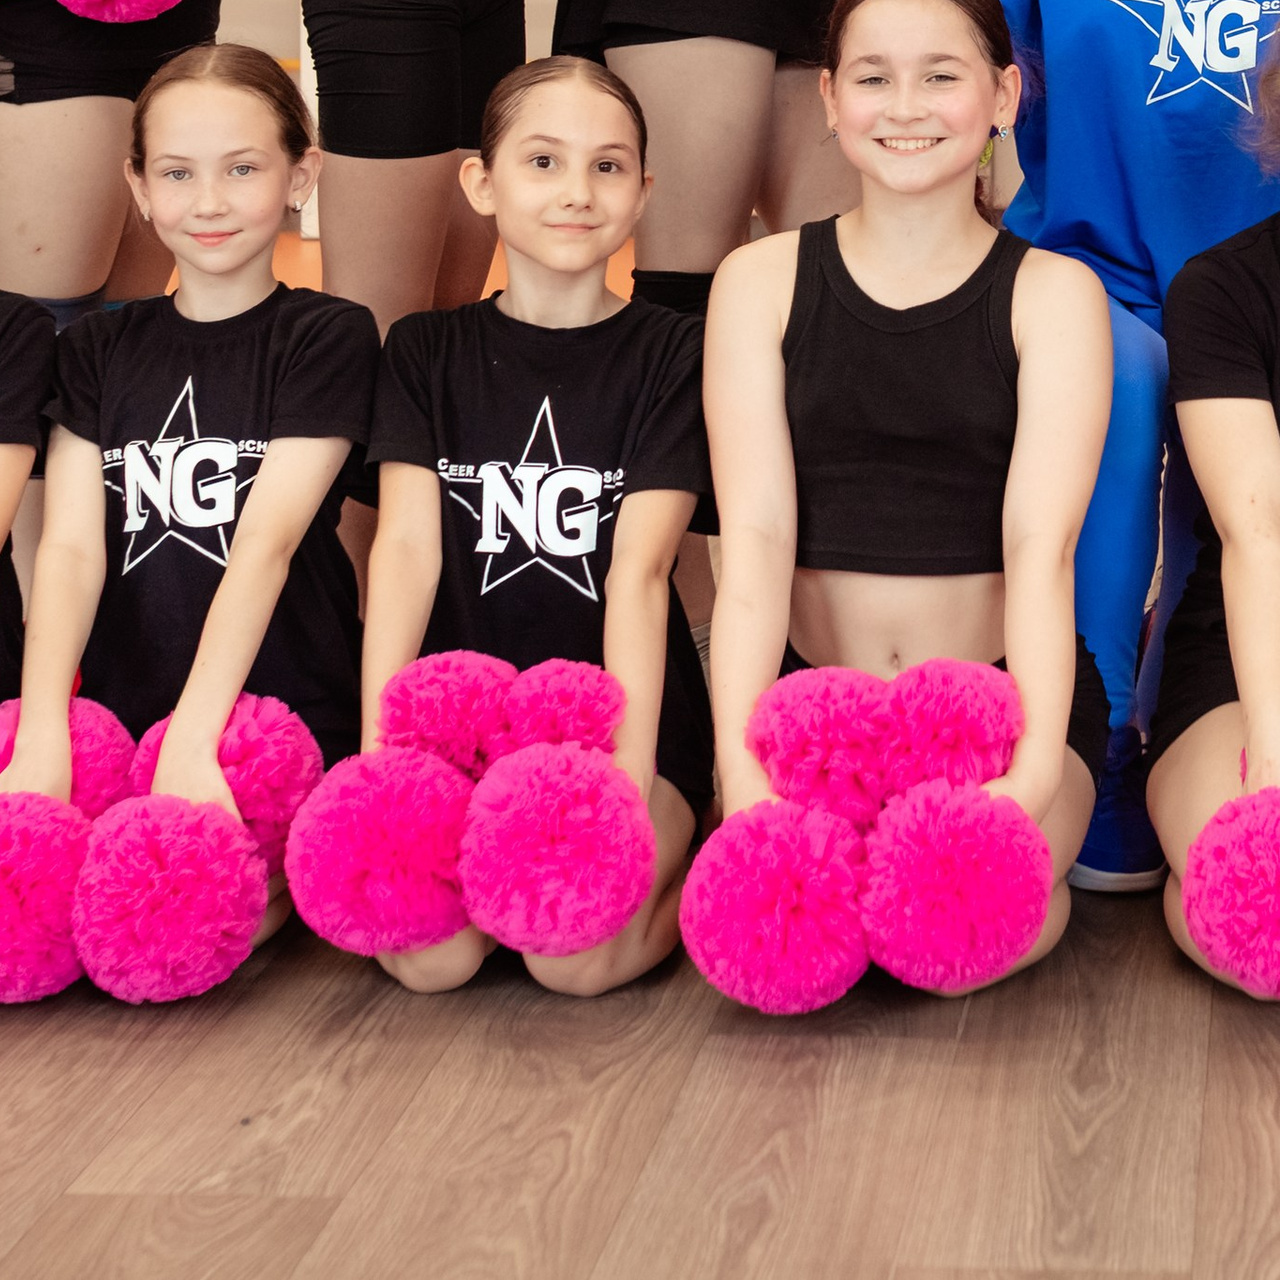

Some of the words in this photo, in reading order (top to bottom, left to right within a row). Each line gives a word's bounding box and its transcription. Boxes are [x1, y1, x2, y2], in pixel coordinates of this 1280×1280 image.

[122, 435, 238, 532] NG
[437, 457, 475, 478] CEER
[474, 460, 602, 557] NG
